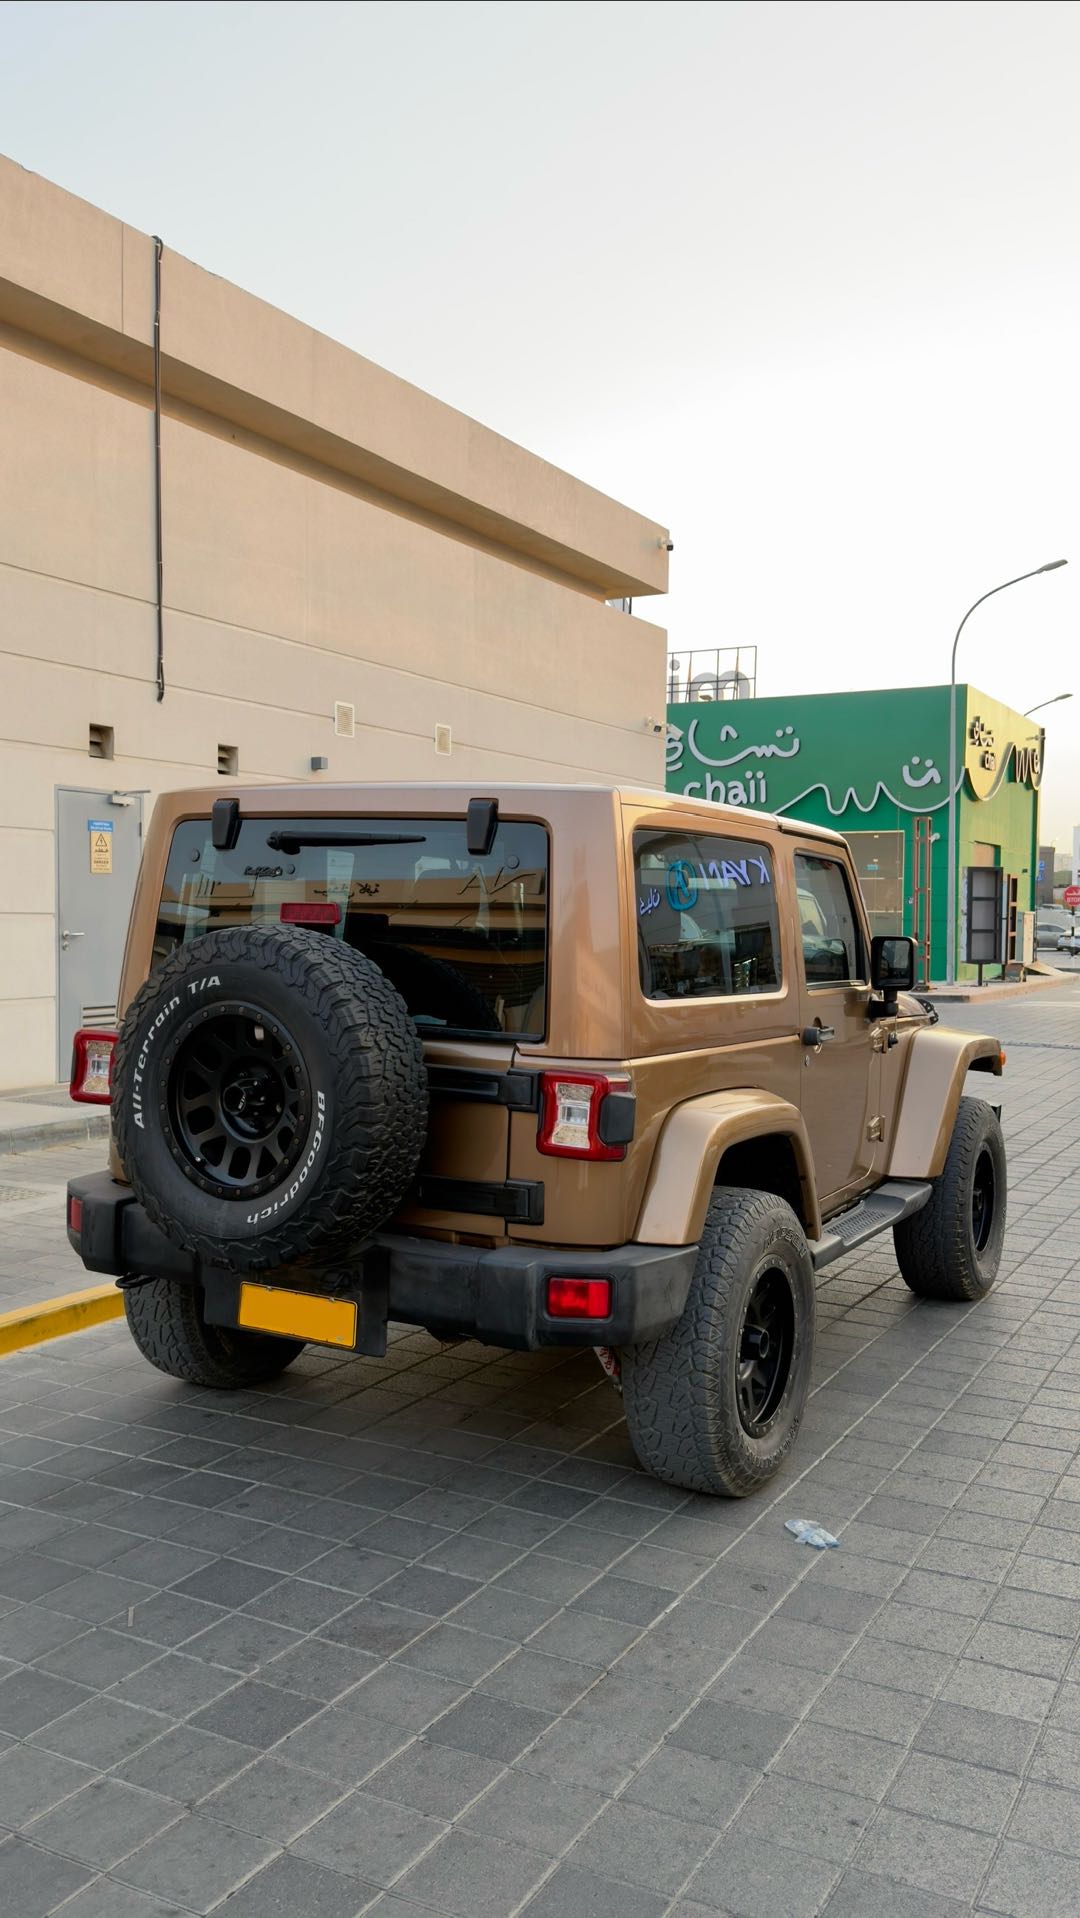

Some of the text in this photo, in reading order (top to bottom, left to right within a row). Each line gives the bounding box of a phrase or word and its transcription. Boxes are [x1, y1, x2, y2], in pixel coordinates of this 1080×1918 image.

[132, 975, 222, 1130] All-Terrain T/A
[246, 1089, 327, 1226] BFGoodrich
